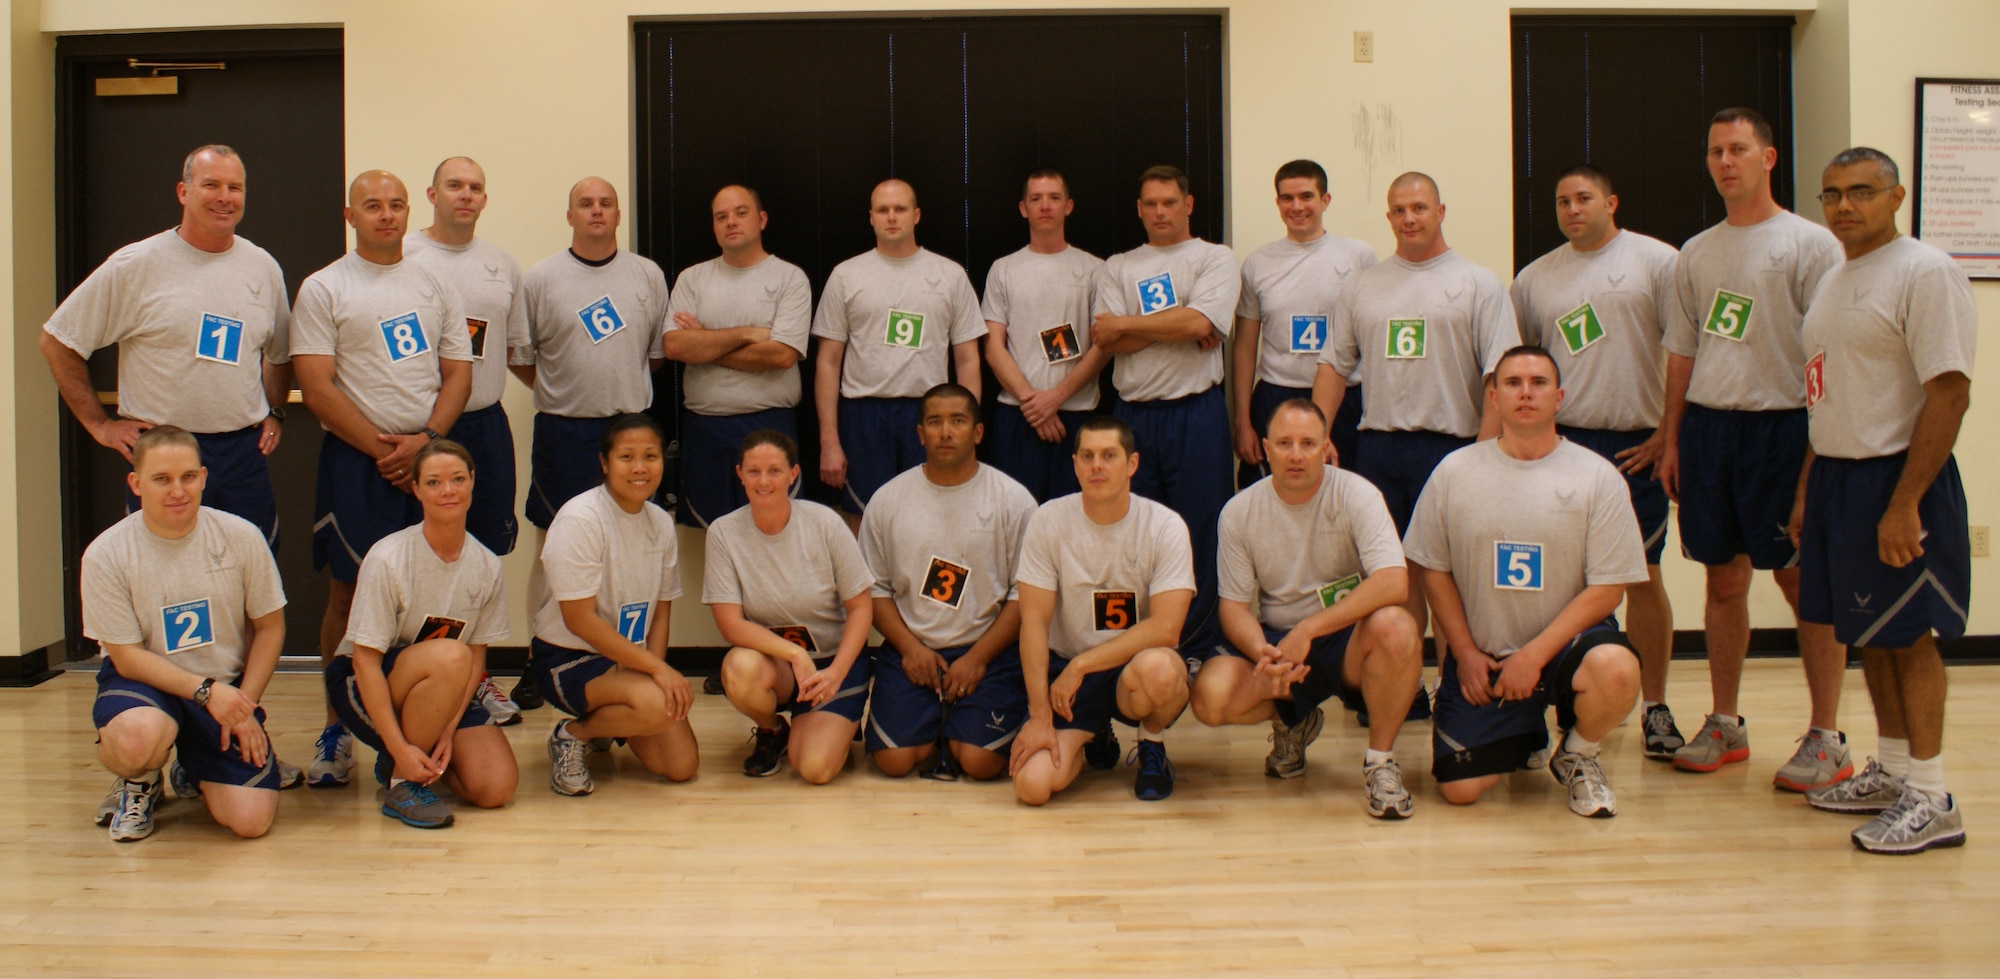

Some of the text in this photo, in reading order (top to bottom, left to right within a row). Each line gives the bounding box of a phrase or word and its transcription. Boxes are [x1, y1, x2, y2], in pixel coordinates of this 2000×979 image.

[1950, 85, 1982, 94] FITNESS
[1955, 98, 1984, 108] Testing
[1148, 282, 1167, 309] 3
[592, 308, 614, 335] 6
[895, 319, 914, 345] 9
[1568, 314, 1588, 346] 7
[1717, 302, 1743, 334] 5
[212, 326, 228, 358] 1
[393, 324, 418, 356] 8
[1052, 332, 1069, 358] 1
[1299, 322, 1319, 350] 4
[1397, 326, 1416, 356] 6
[1810, 368, 1819, 402] 3
[1500, 543, 1511, 551] FAC
[1507, 552, 1532, 586] 5
[932, 569, 956, 601] 3
[180, 602, 206, 610] TESTING
[1105, 599, 1127, 630] 5
[175, 611, 201, 647] 2
[626, 611, 641, 641] 7
